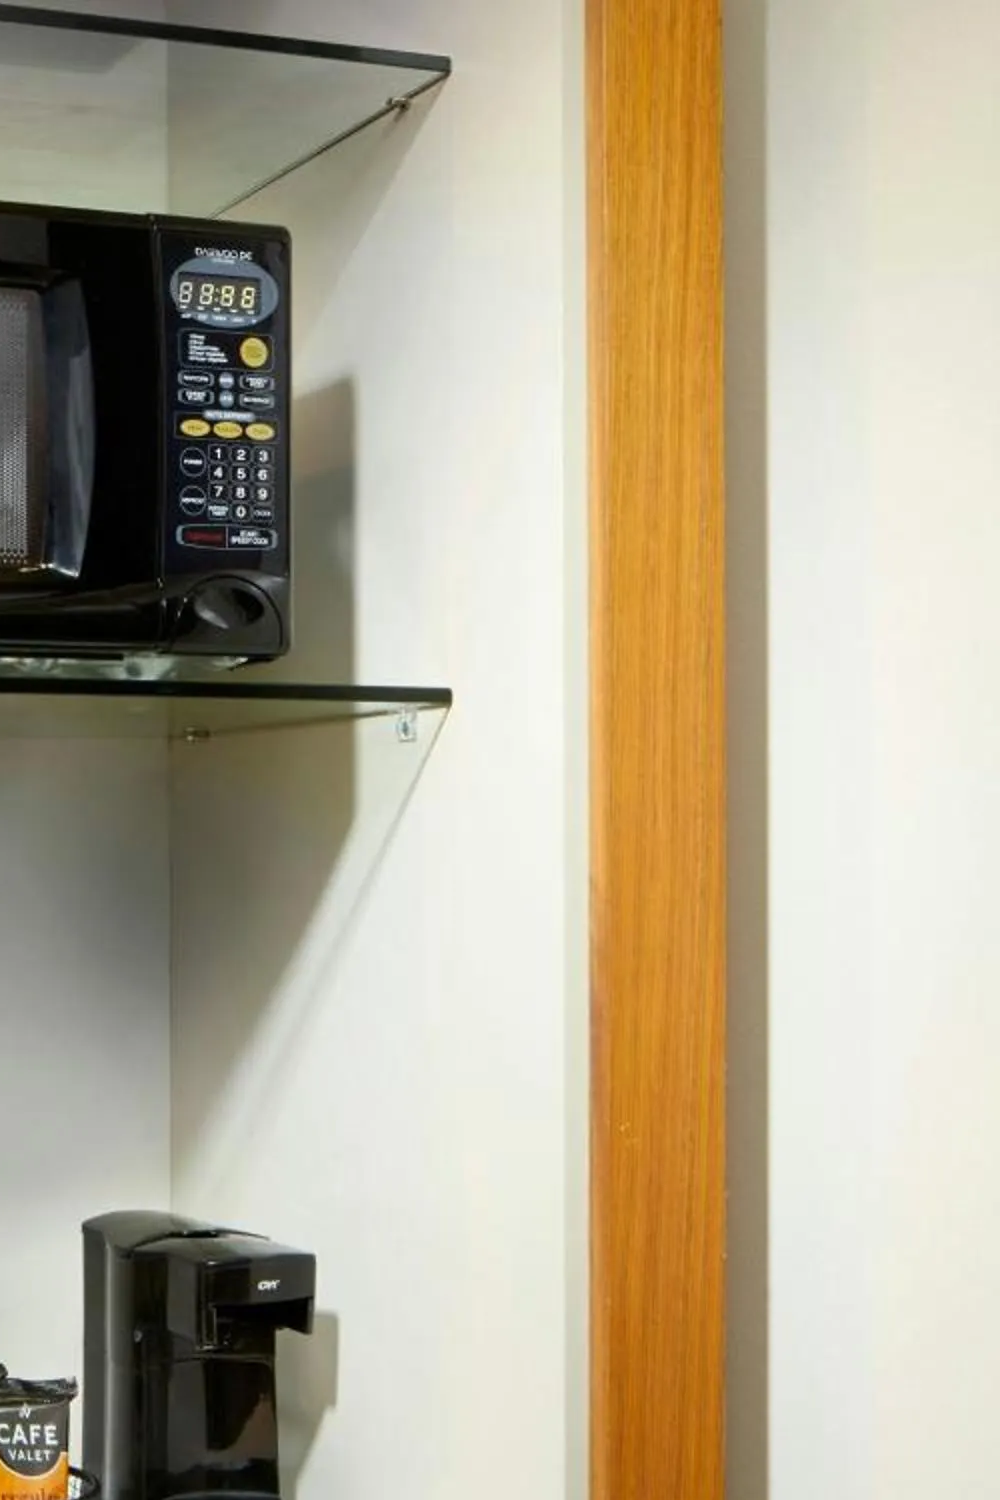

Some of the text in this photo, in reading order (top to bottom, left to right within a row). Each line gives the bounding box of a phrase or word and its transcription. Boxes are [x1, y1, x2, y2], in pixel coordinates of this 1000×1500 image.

[216, 448, 268, 462] 1 2 3
[214, 467, 267, 480] 4 5 6
[215, 486, 267, 500] 7 8 9
[236, 506, 246, 518] 0
[8, 1449, 51, 1462] VALET
